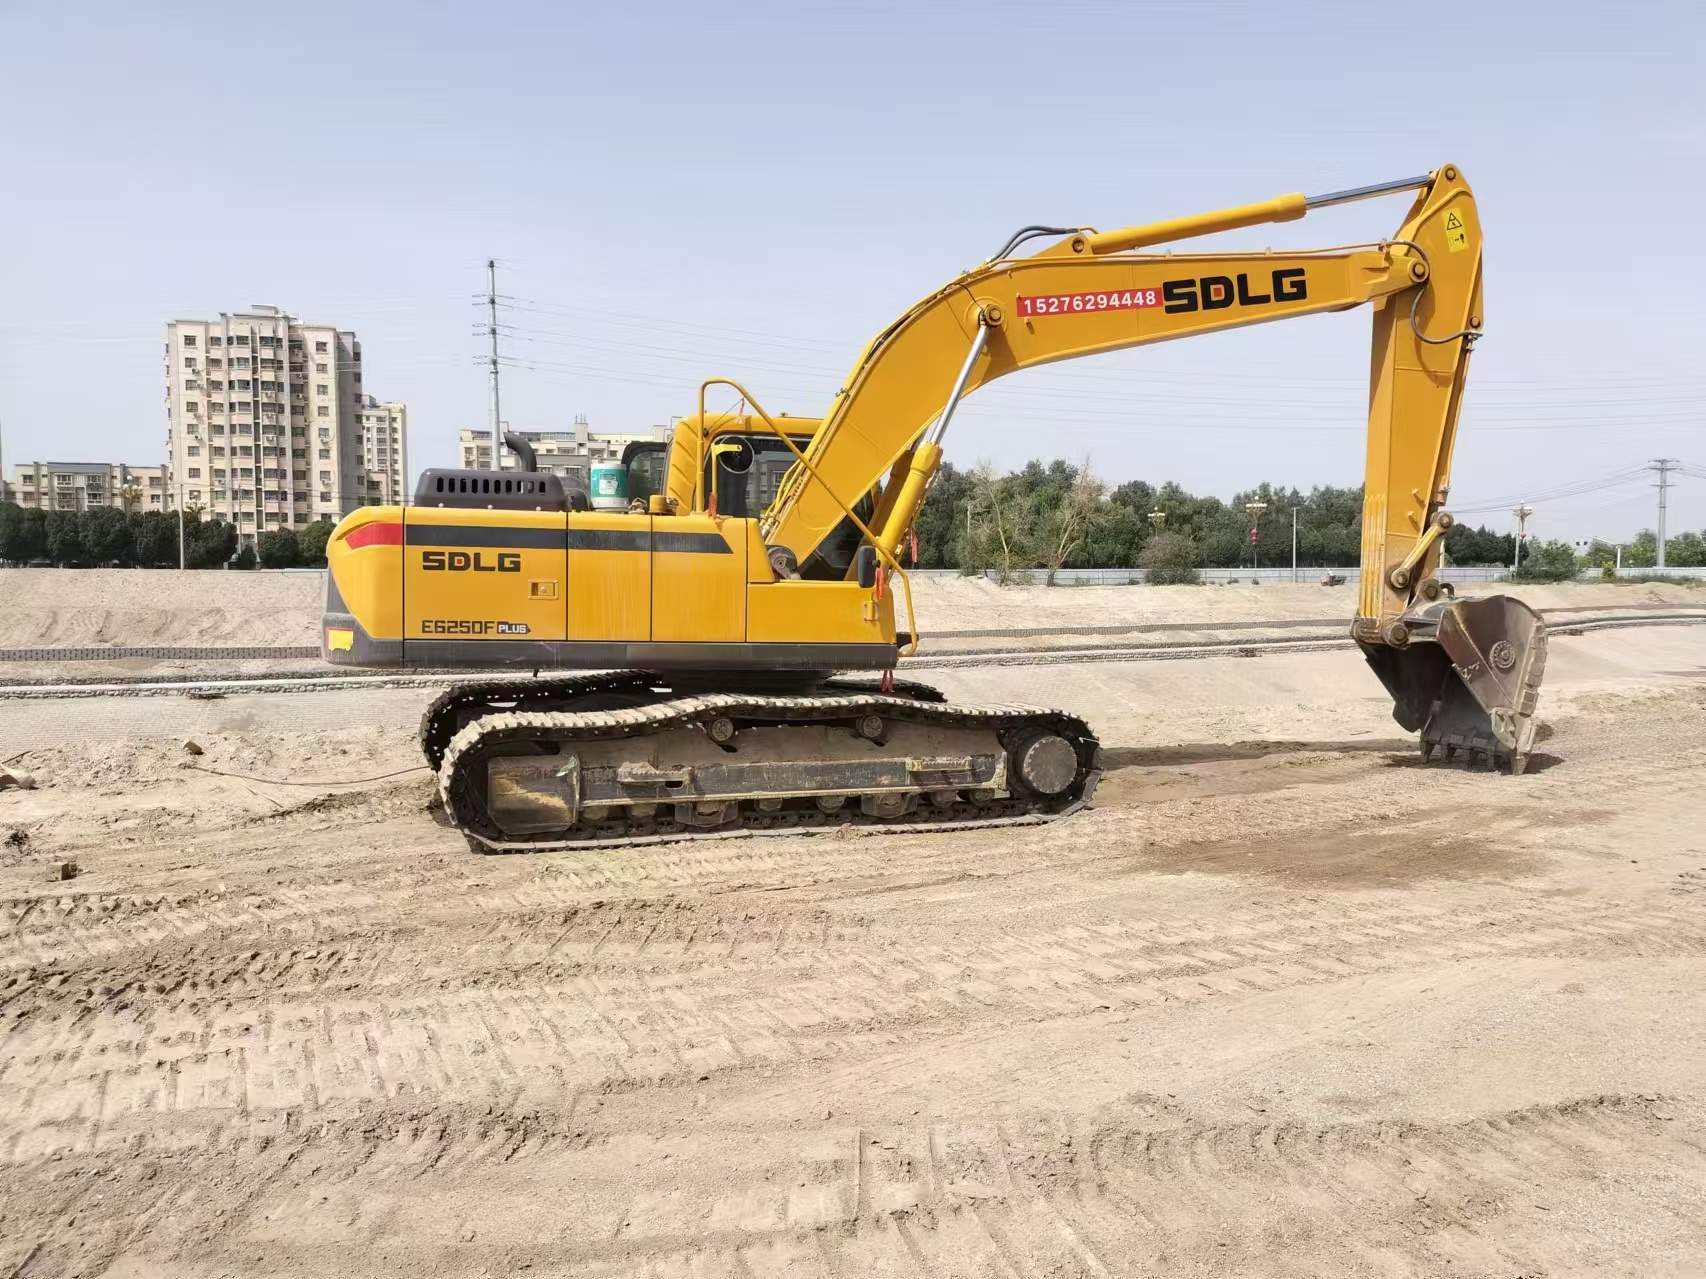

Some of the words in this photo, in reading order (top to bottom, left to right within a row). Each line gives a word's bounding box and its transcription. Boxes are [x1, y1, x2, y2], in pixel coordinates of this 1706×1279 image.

[1024, 290, 1156, 313] 15276294448
[1163, 268, 1307, 314] SDLG
[422, 551, 521, 572] SDLG
[422, 620, 495, 634] E6250F
[498, 624, 528, 634] PLUS
